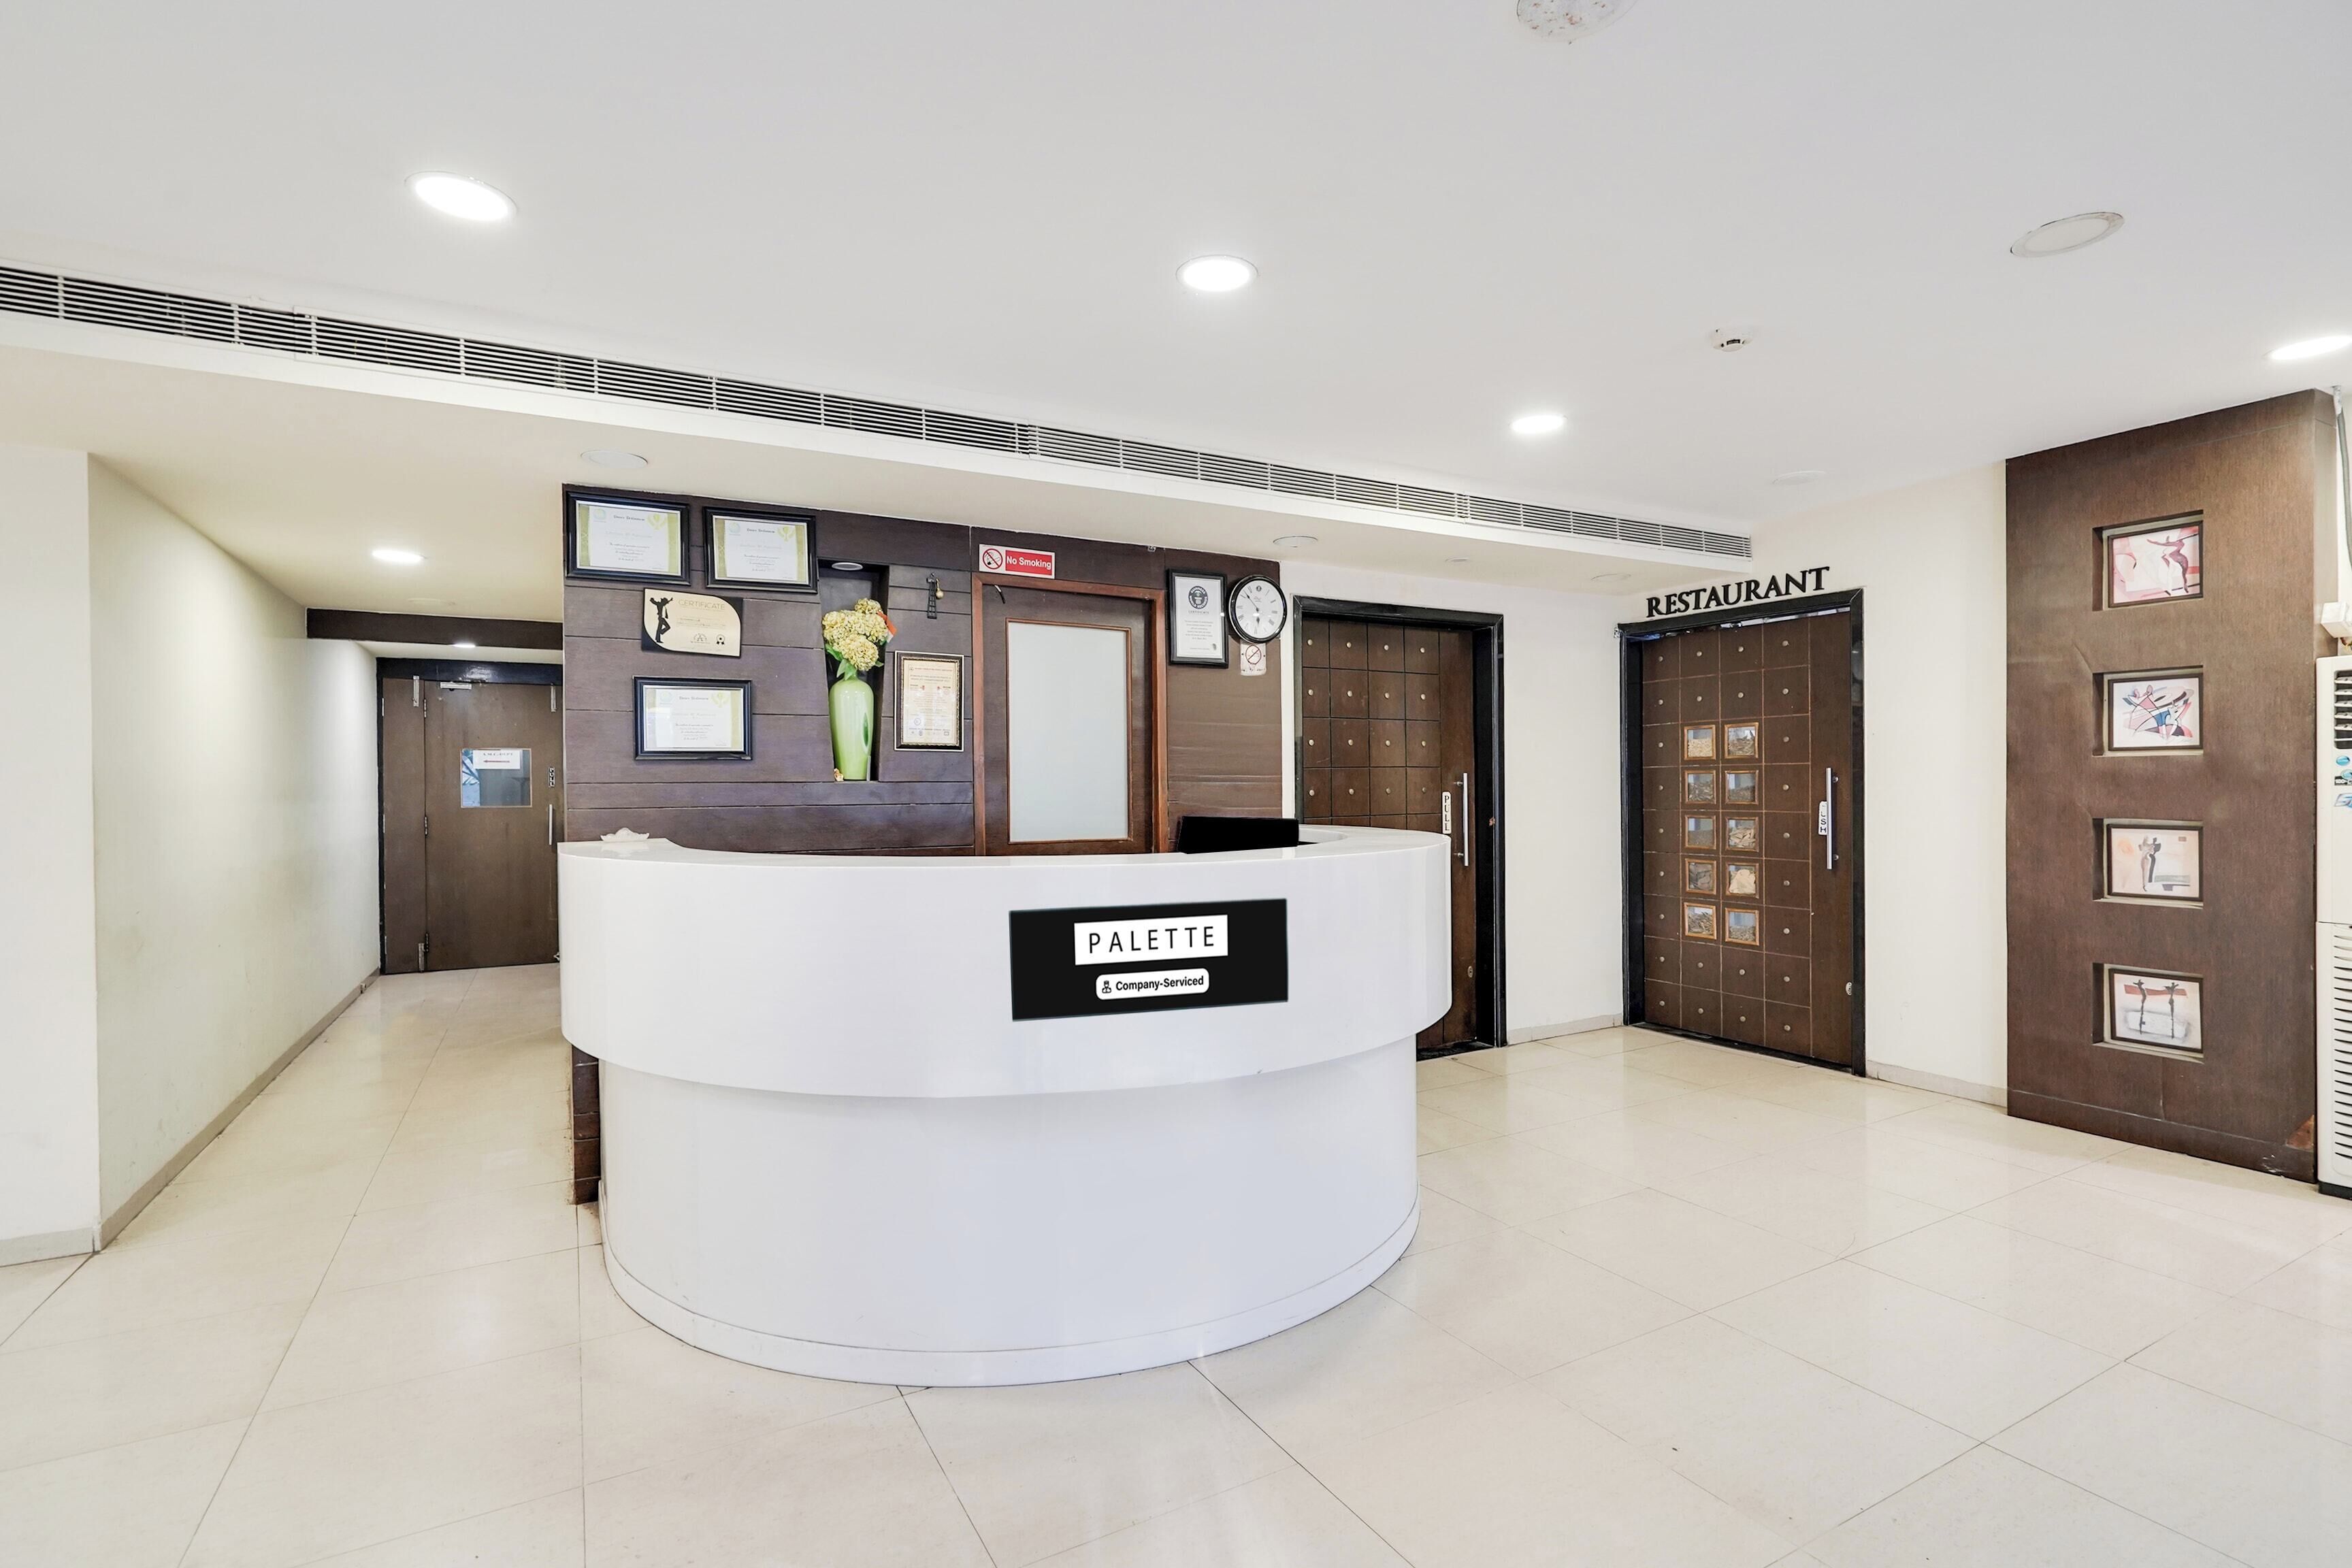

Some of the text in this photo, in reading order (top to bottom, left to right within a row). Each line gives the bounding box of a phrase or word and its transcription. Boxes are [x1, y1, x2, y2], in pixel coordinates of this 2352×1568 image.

[1007, 555, 1051, 570] No Smoking
[1646, 566, 1830, 618] RESTAURANT
[678, 599, 725, 610] CERTIFICATE
[1090, 926, 1214, 953] PALETTE
[1115, 976, 1204, 992] Company-Serviced
